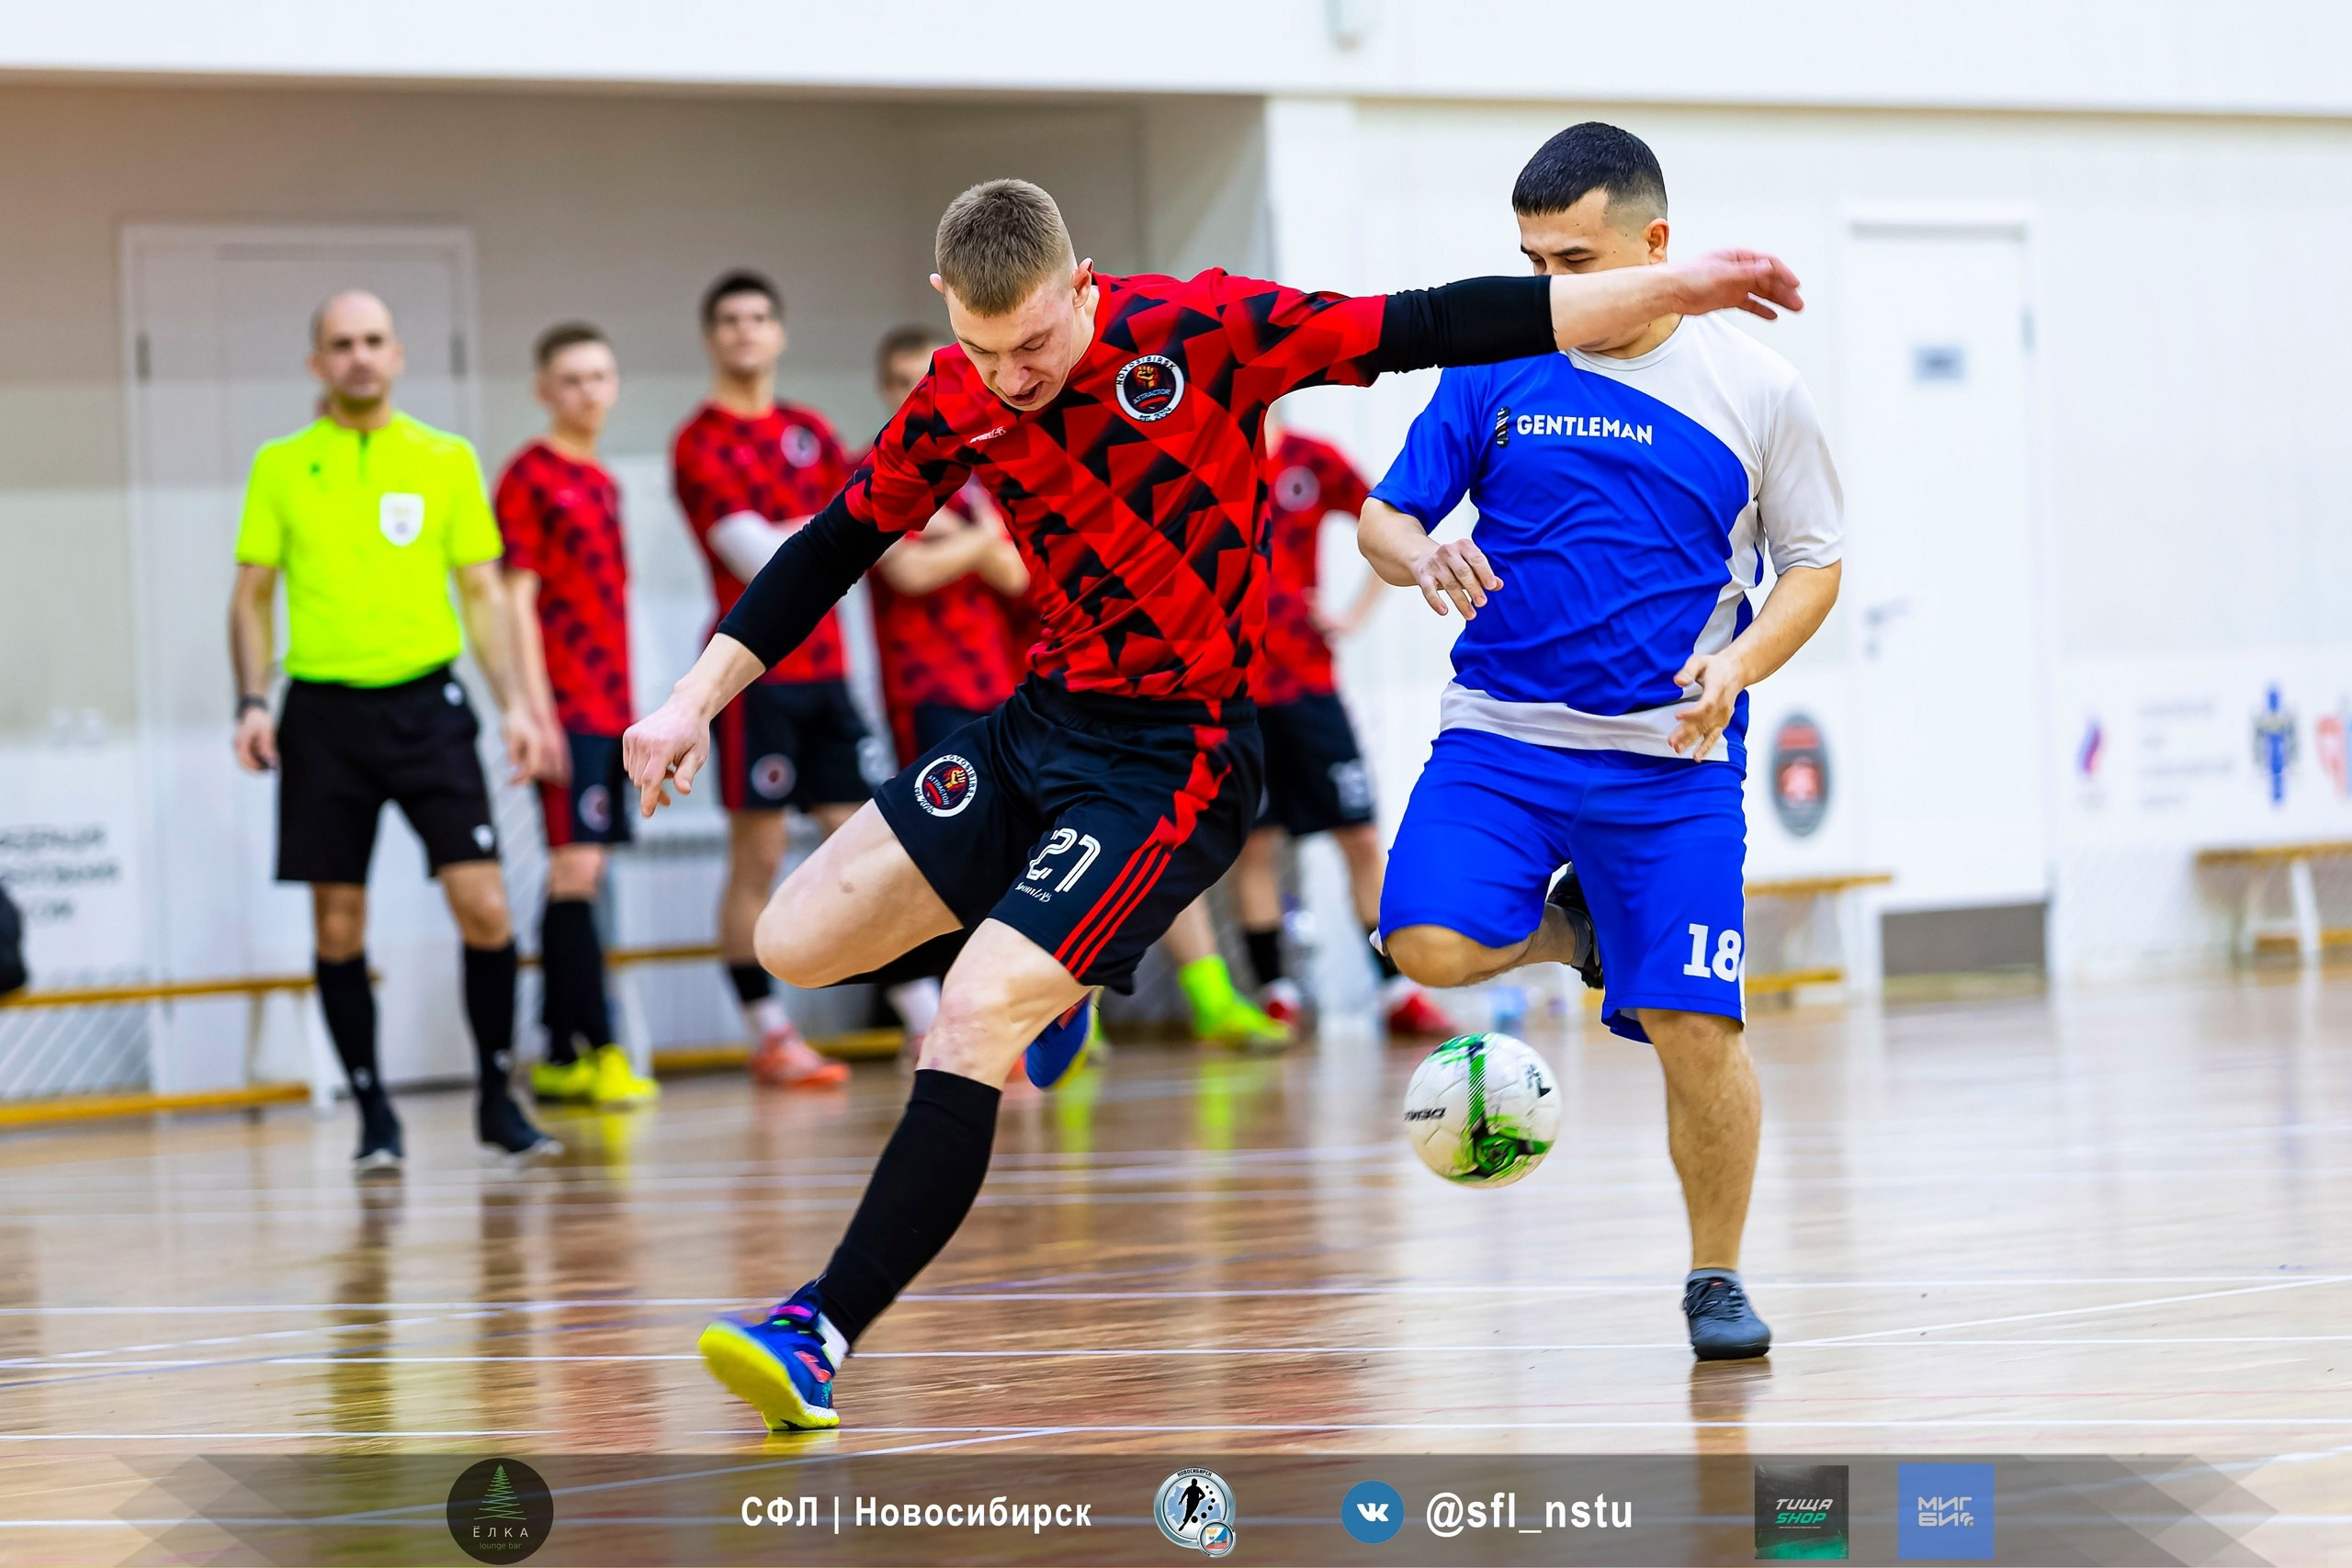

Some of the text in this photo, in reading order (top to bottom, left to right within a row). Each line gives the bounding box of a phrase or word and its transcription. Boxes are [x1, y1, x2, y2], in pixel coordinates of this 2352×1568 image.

[1517, 414, 1652, 446] GENTLEMAN
[927, 774, 950, 806] ATTRACTOR
[1025, 828, 1102, 894] 27
[1683, 923, 1742, 983] 18
